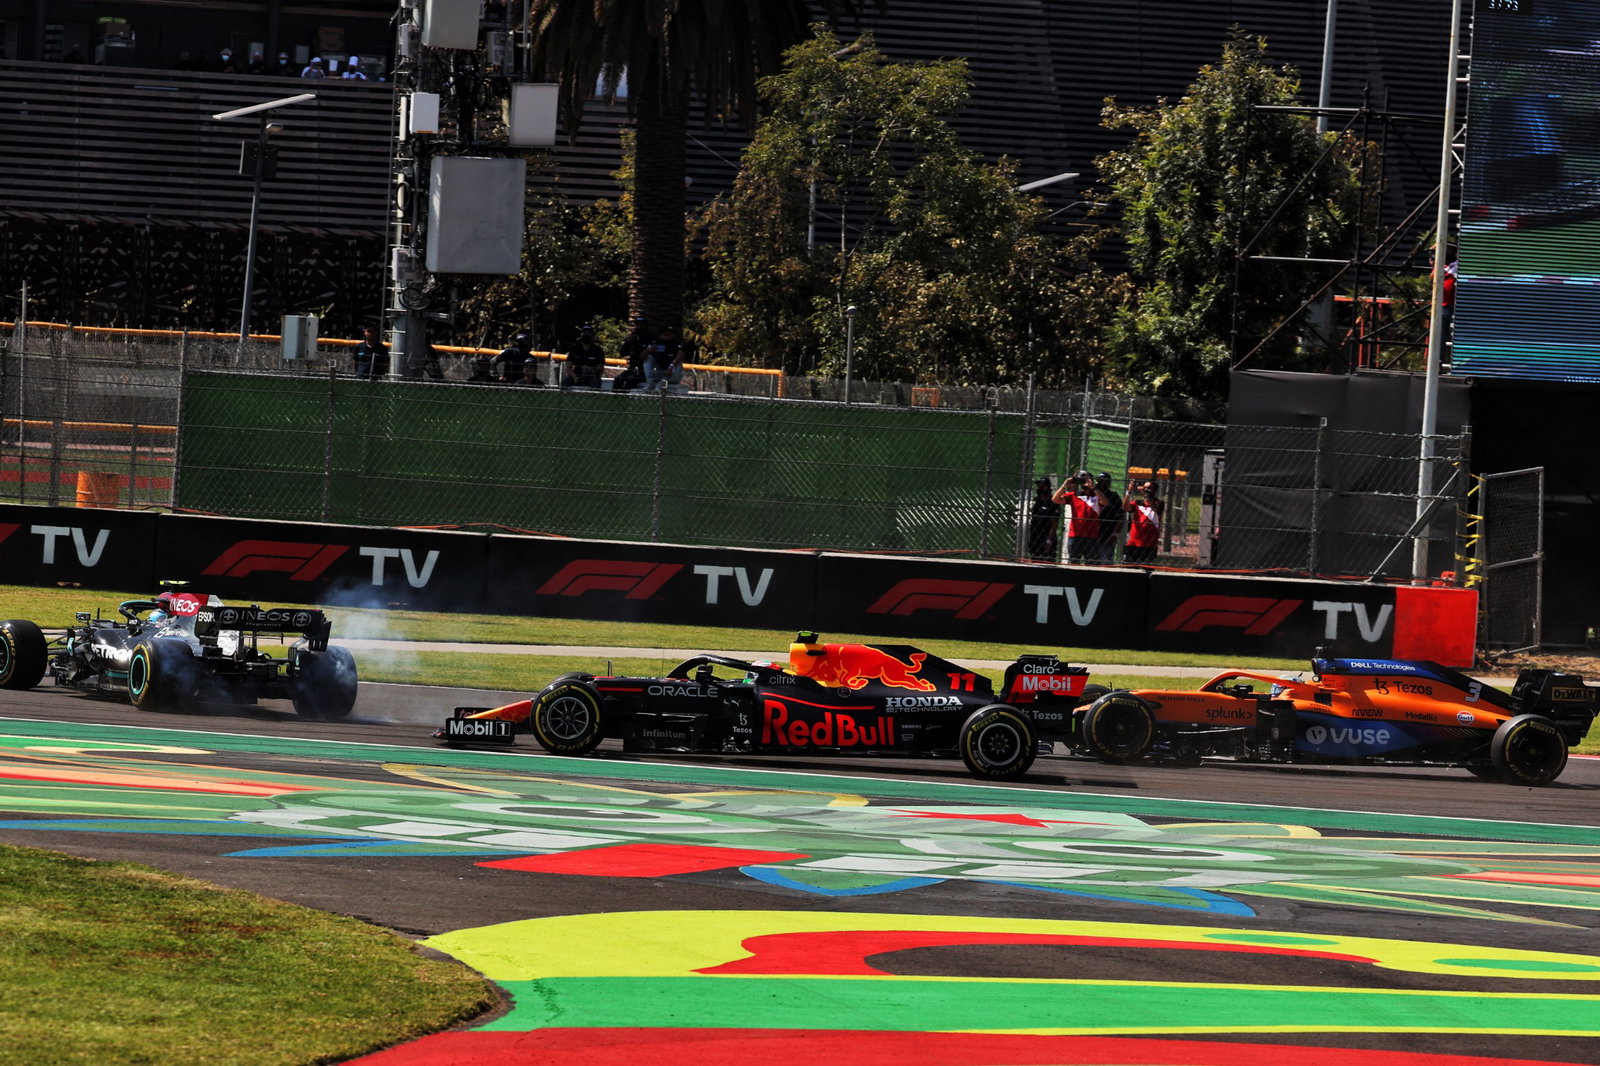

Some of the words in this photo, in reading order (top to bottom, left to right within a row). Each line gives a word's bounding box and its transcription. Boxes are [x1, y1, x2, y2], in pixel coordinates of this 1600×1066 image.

[30, 525, 110, 567] TV
[359, 546, 440, 589] TV
[693, 564, 774, 606] TV
[169, 598, 199, 613] INEOS
[1023, 585, 1104, 627] TV
[198, 611, 216, 623] EPSON
[241, 610, 291, 622] INEOS
[1313, 600, 1393, 643] TV
[1372, 662, 1416, 672] Technologies
[769, 674, 798, 686] citrix
[946, 672, 977, 692] 11
[1022, 676, 1071, 692] Mobil
[647, 685, 719, 698] ORACLE
[1393, 681, 1433, 696] Tezos
[1465, 682, 1483, 703] 3
[886, 696, 964, 707] HONDA
[1032, 710, 1063, 721] Tezos
[1405, 711, 1438, 722] Medallia
[449, 720, 494, 736] Mobil
[642, 729, 687, 740] Infinitum
[733, 726, 753, 735] Tezos
